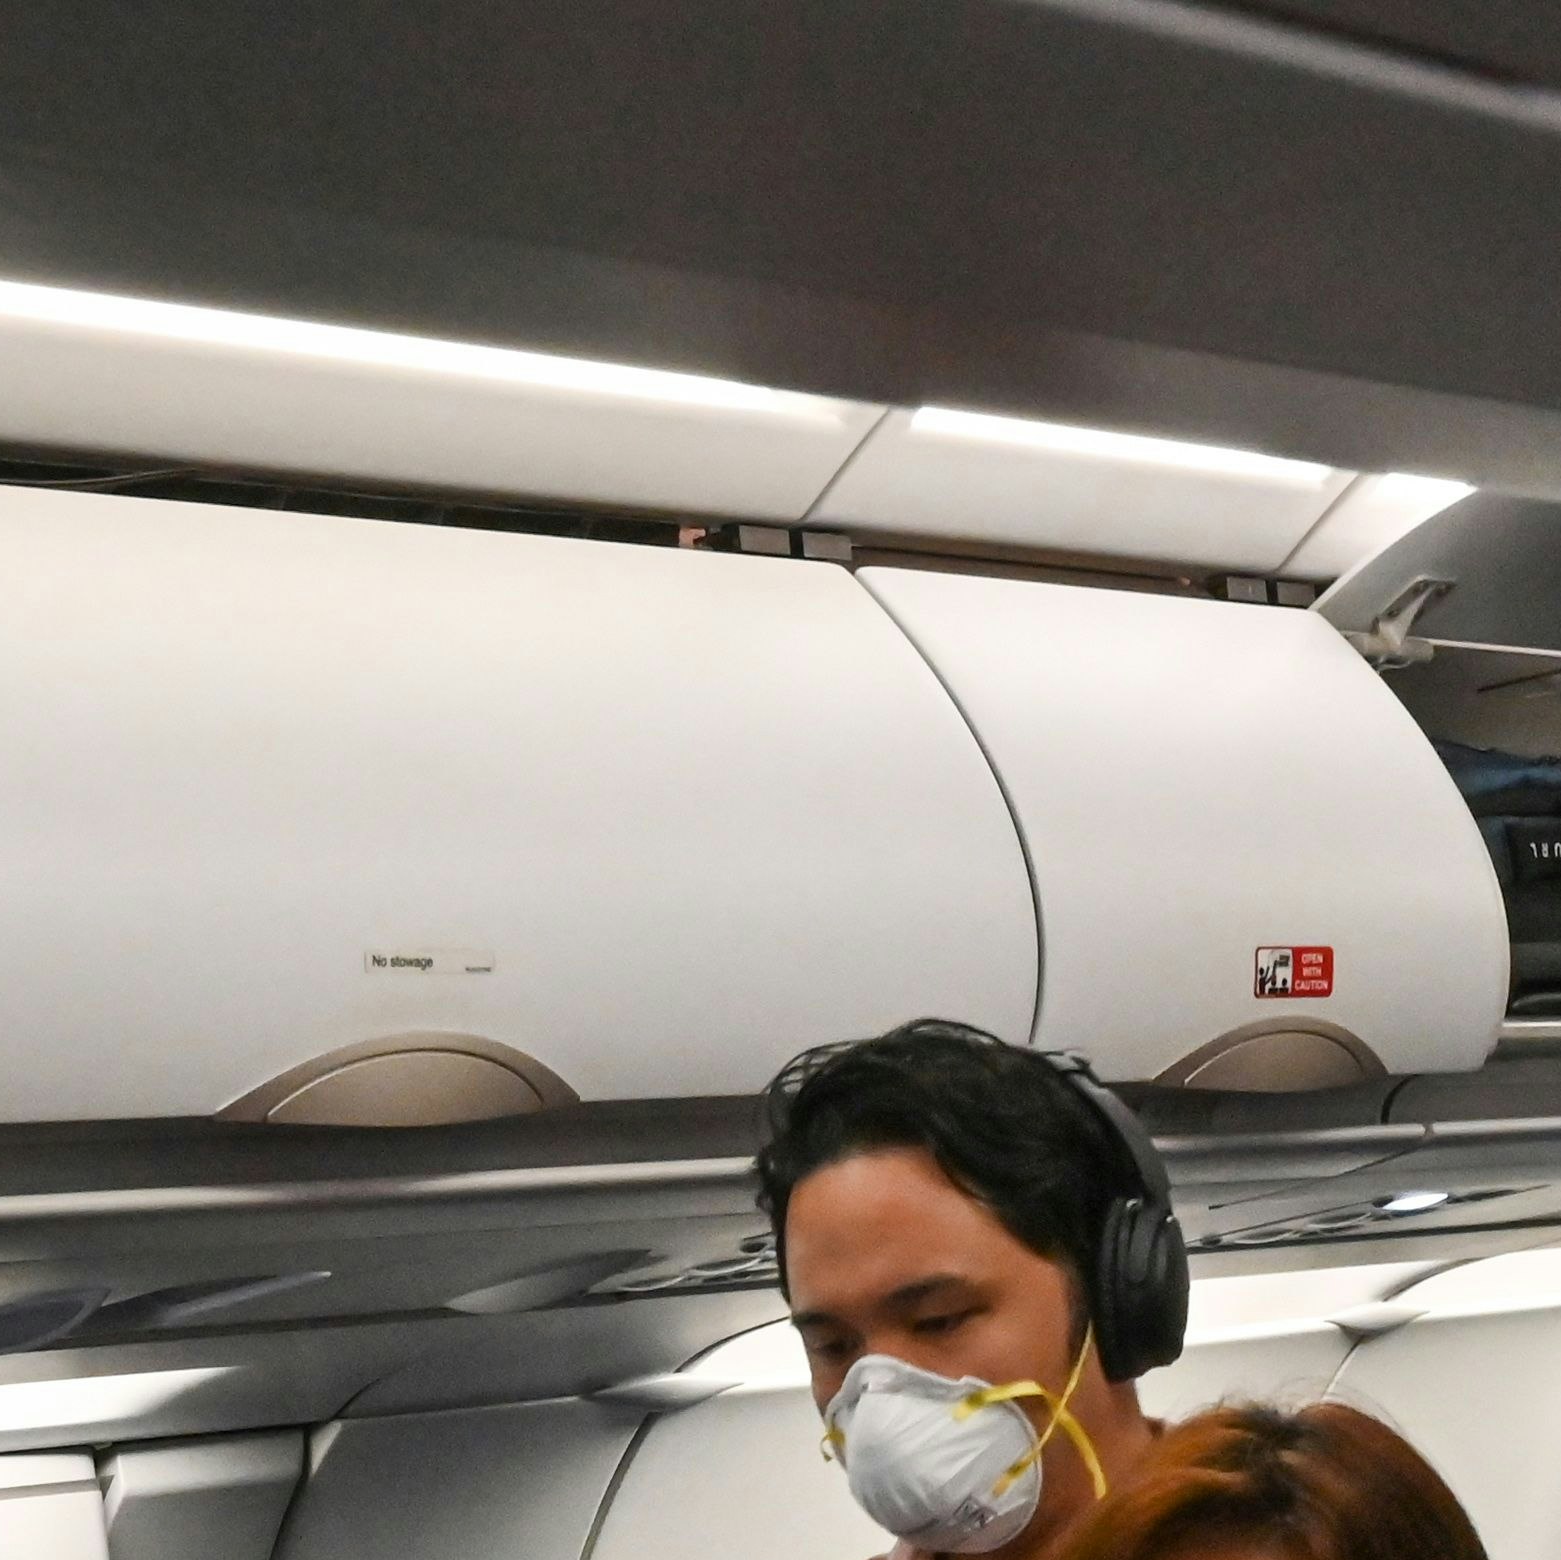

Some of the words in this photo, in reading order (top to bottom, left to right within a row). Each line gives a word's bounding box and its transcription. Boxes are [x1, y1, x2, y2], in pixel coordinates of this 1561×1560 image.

[372, 955, 387, 967] No
[390, 955, 433, 971] stowage
[1294, 979, 1328, 991] CAUTION
